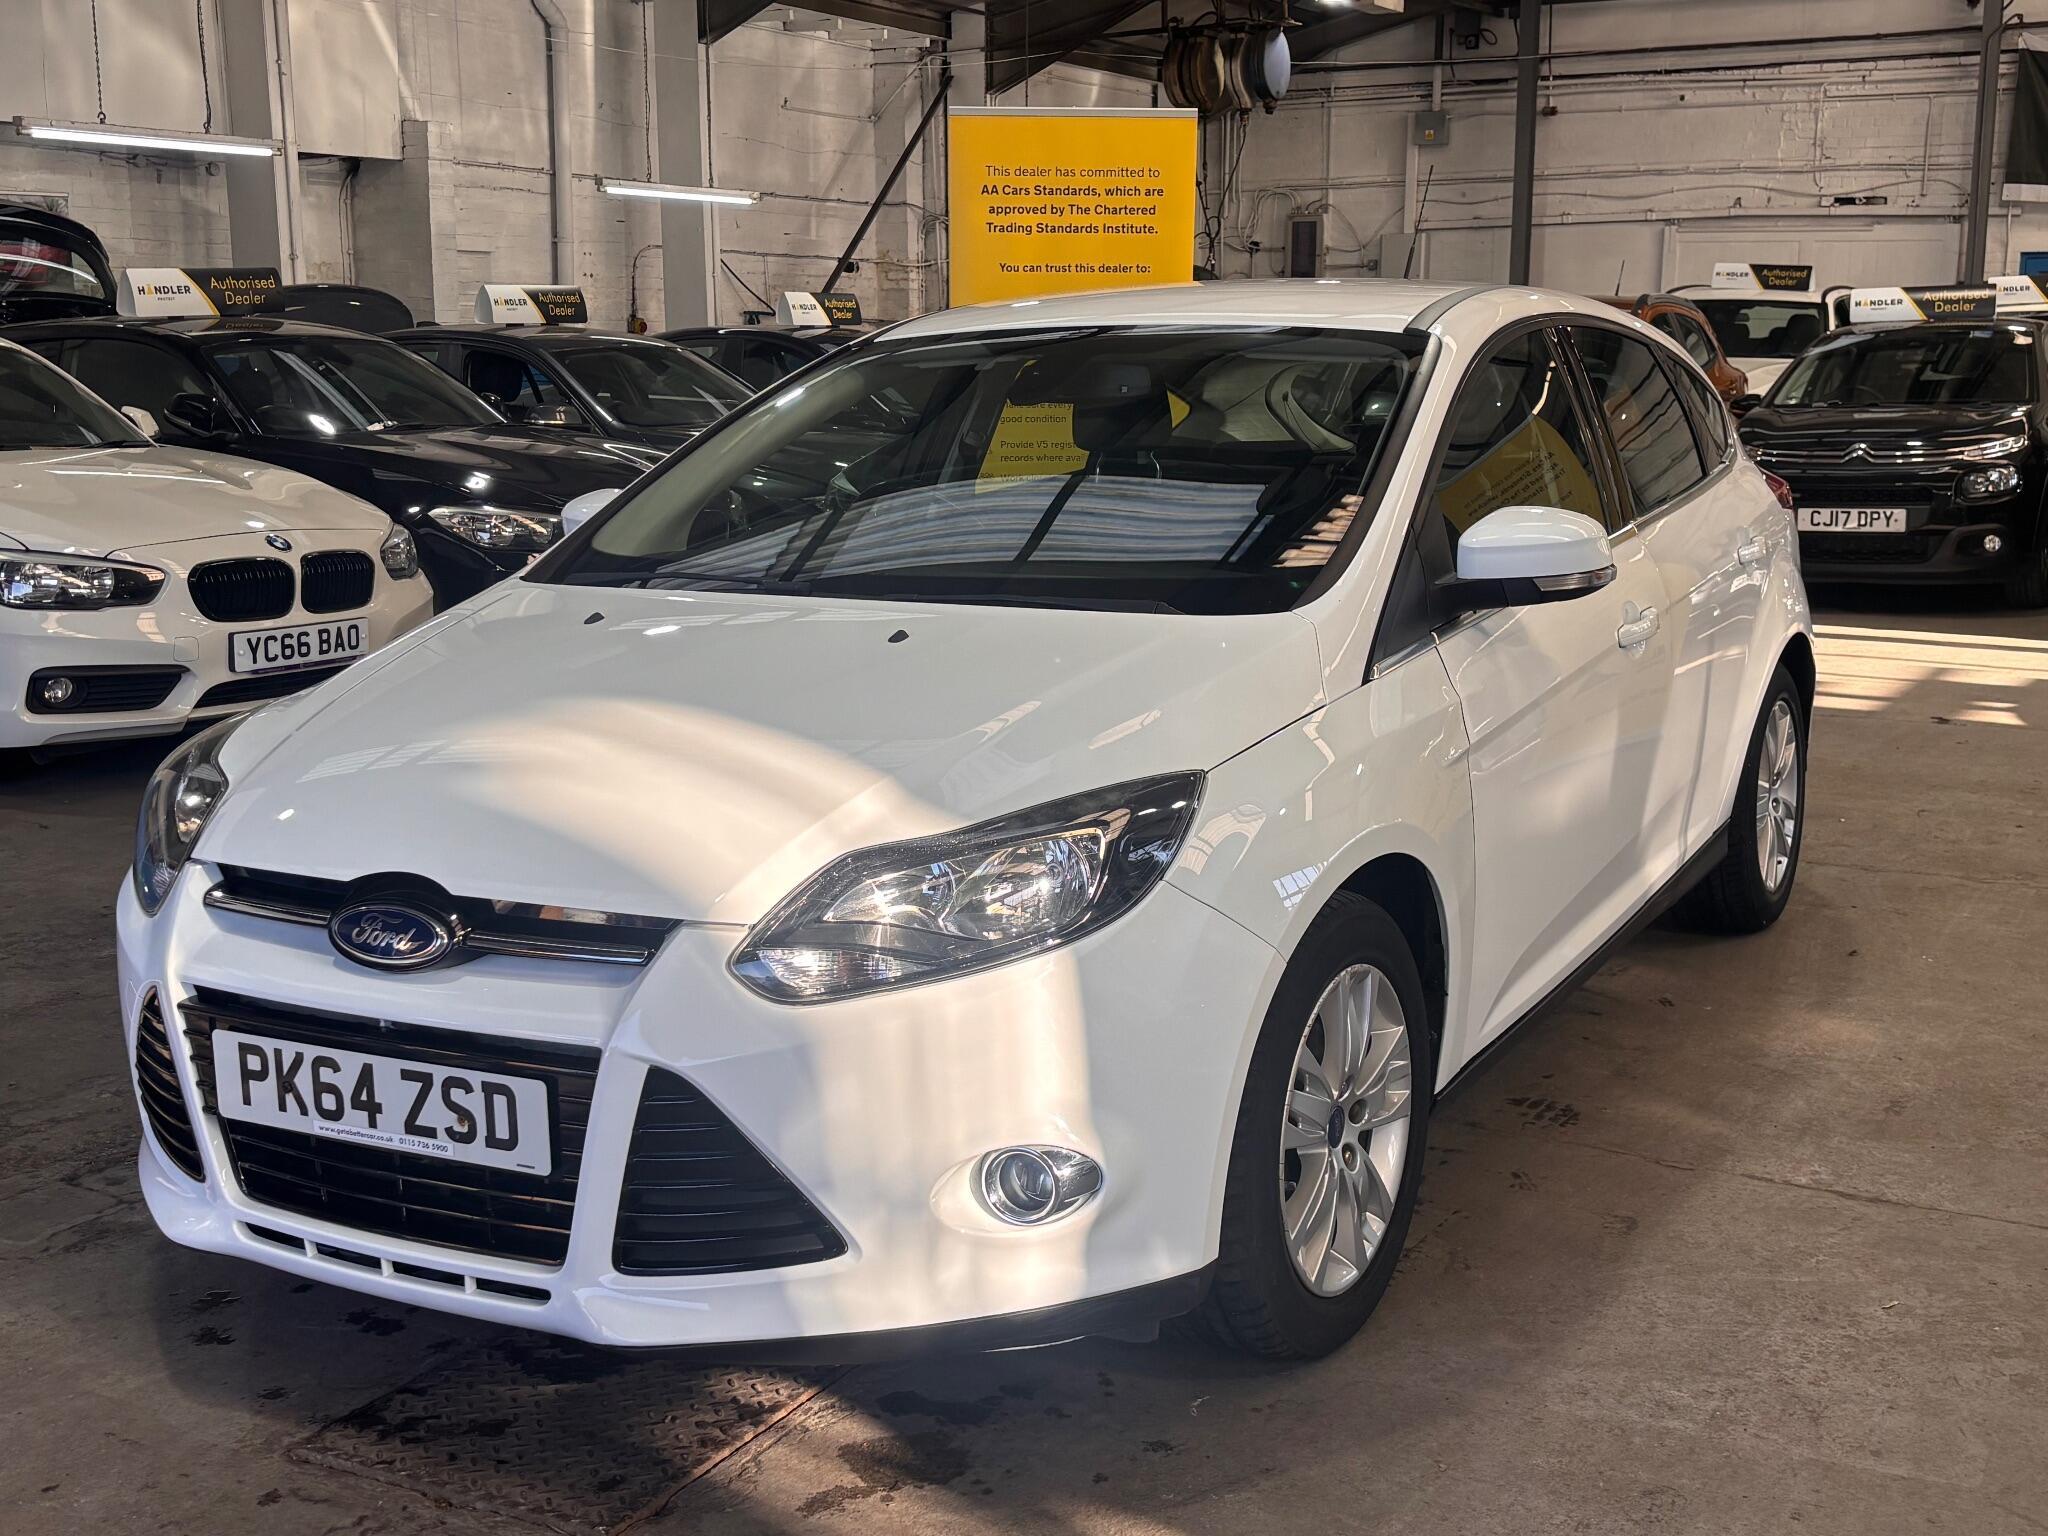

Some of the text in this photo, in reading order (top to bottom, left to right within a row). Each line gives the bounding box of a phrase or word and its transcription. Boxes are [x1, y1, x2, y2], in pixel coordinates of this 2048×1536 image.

[985, 165, 1161, 178] This dealer has committed to
[981, 185, 1164, 197] AA Cars Standards, which are
[988, 204, 1156, 217] approved by The Chartered
[986, 222, 1158, 235] Trading Standards Institute.
[999, 263, 1151, 273] You can trust this dealer to:
[1761, 268, 1808, 278] Authorised
[210, 275, 276, 289] Authorised
[1768, 277, 1797, 286] Dealer
[225, 290, 266, 305] Dealer
[539, 291, 581, 303] Authorised
[1922, 289, 1989, 302] Authorised
[825, 298, 857, 309] Authorised
[1934, 302, 1976, 313] Dealer
[548, 304, 576, 316] Dealer
[832, 309, 853, 319] Dealer
[1000, 415, 1067, 424] good condition
[1000, 440, 1034, 449] Provide
[1036, 440, 1049, 449] V5
[1000, 453, 1034, 462] records
[1036, 453, 1064, 462] where
[1810, 510, 1894, 528] CJ17 DPY
[246, 624, 360, 665] YC66 BAO
[351, 912, 425, 951] Ford
[238, 1041, 519, 1151] PK64 ZSD
[318, 1125, 394, 1143] www.getabettercar.co.uk
[398, 1137, 416, 1147] 0115
